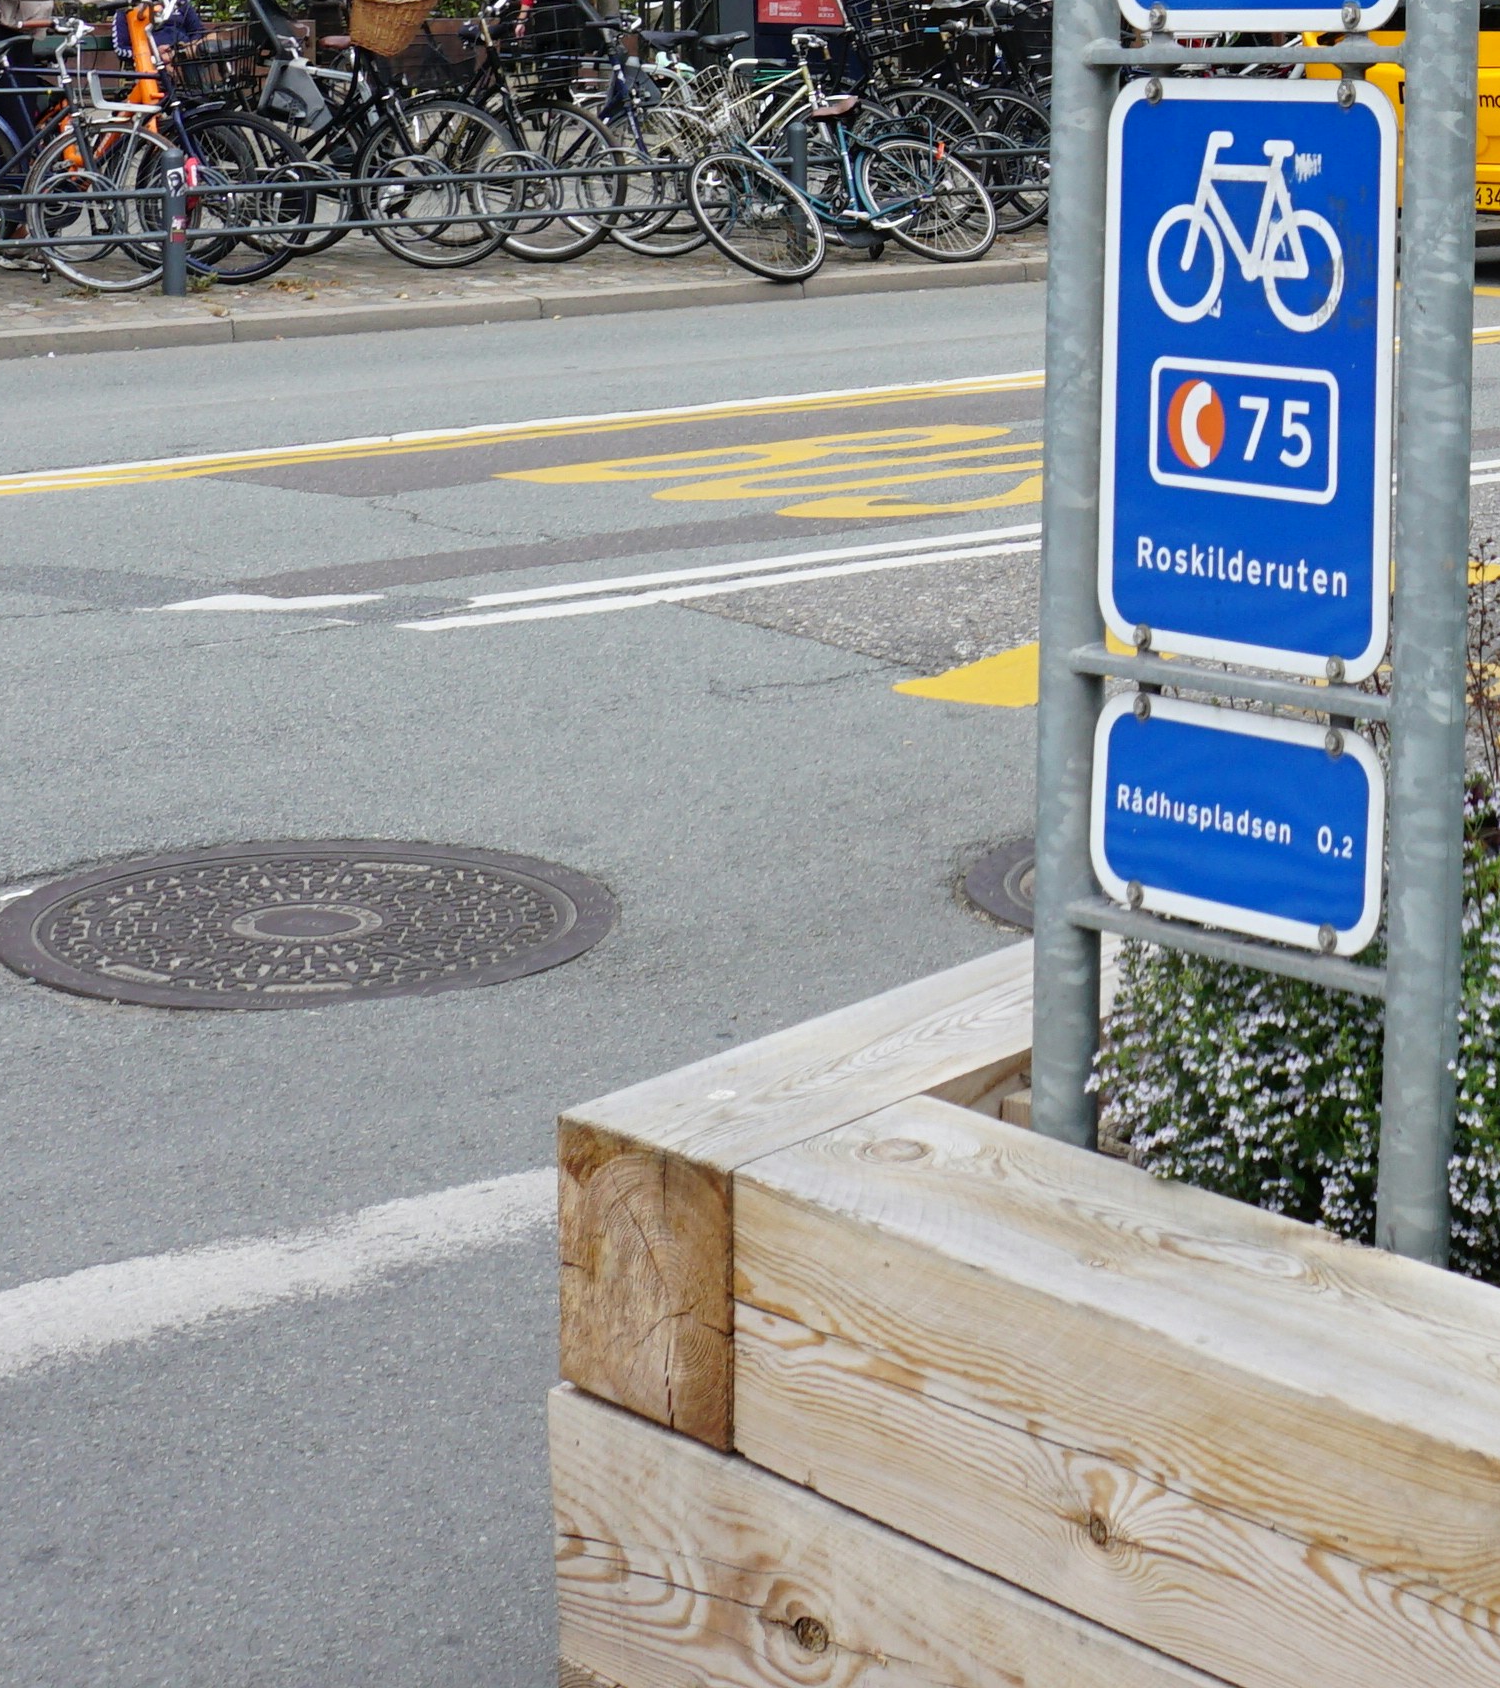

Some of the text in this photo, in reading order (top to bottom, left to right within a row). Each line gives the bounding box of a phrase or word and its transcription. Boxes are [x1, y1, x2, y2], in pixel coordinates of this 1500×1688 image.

[1238, 395, 1313, 469] 75
[1136, 535, 1348, 599] Roskilderuten
[1116, 781, 1291, 845] Rådhuspladsen
